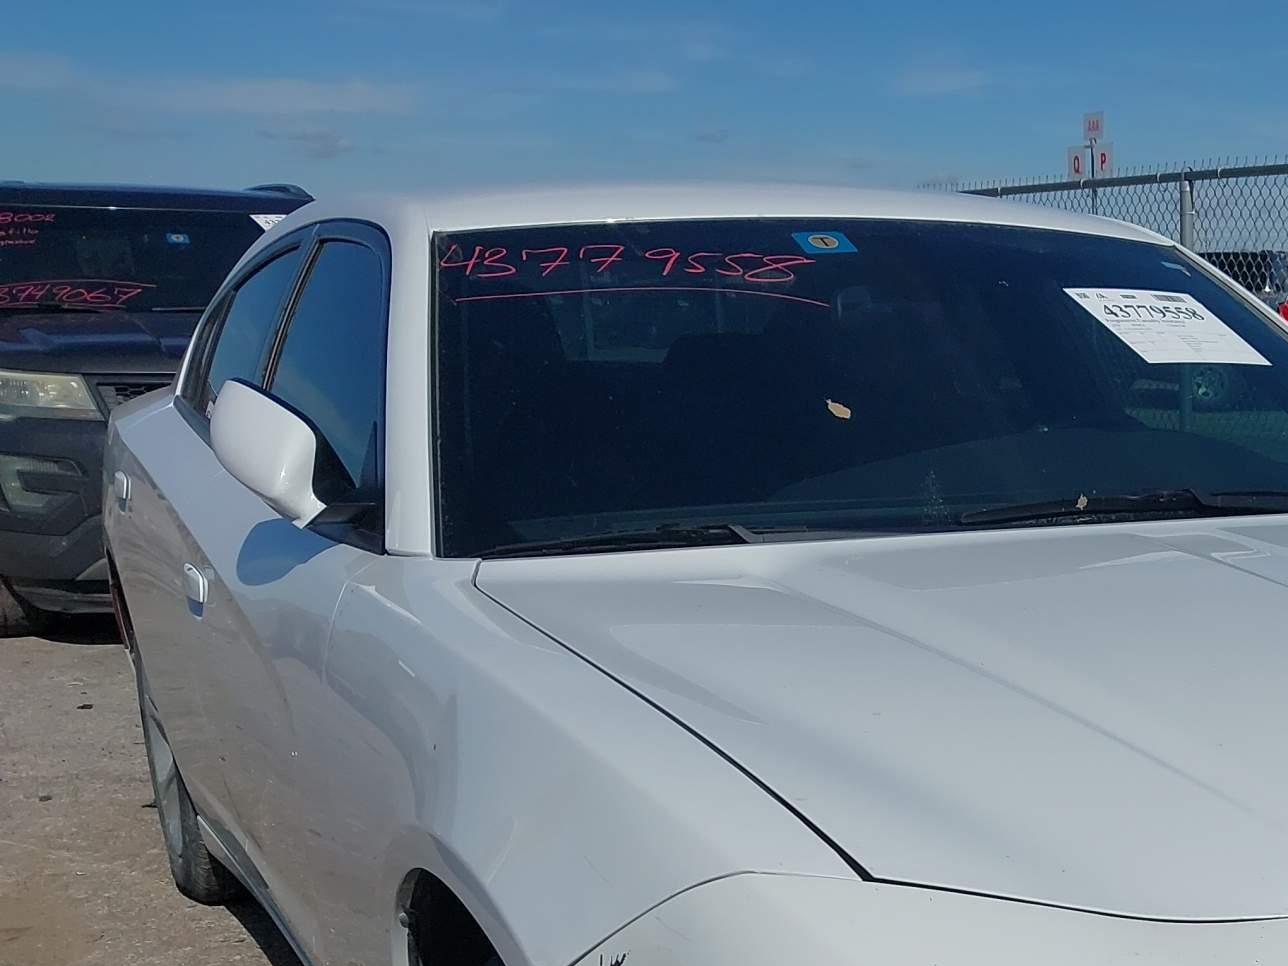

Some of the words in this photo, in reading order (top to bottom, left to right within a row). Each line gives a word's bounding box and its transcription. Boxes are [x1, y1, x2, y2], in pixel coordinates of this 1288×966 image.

[1100, 152, 1107, 171] P
[439, 243, 816, 283] 43779558
[1103, 304, 1206, 321] 43779558
